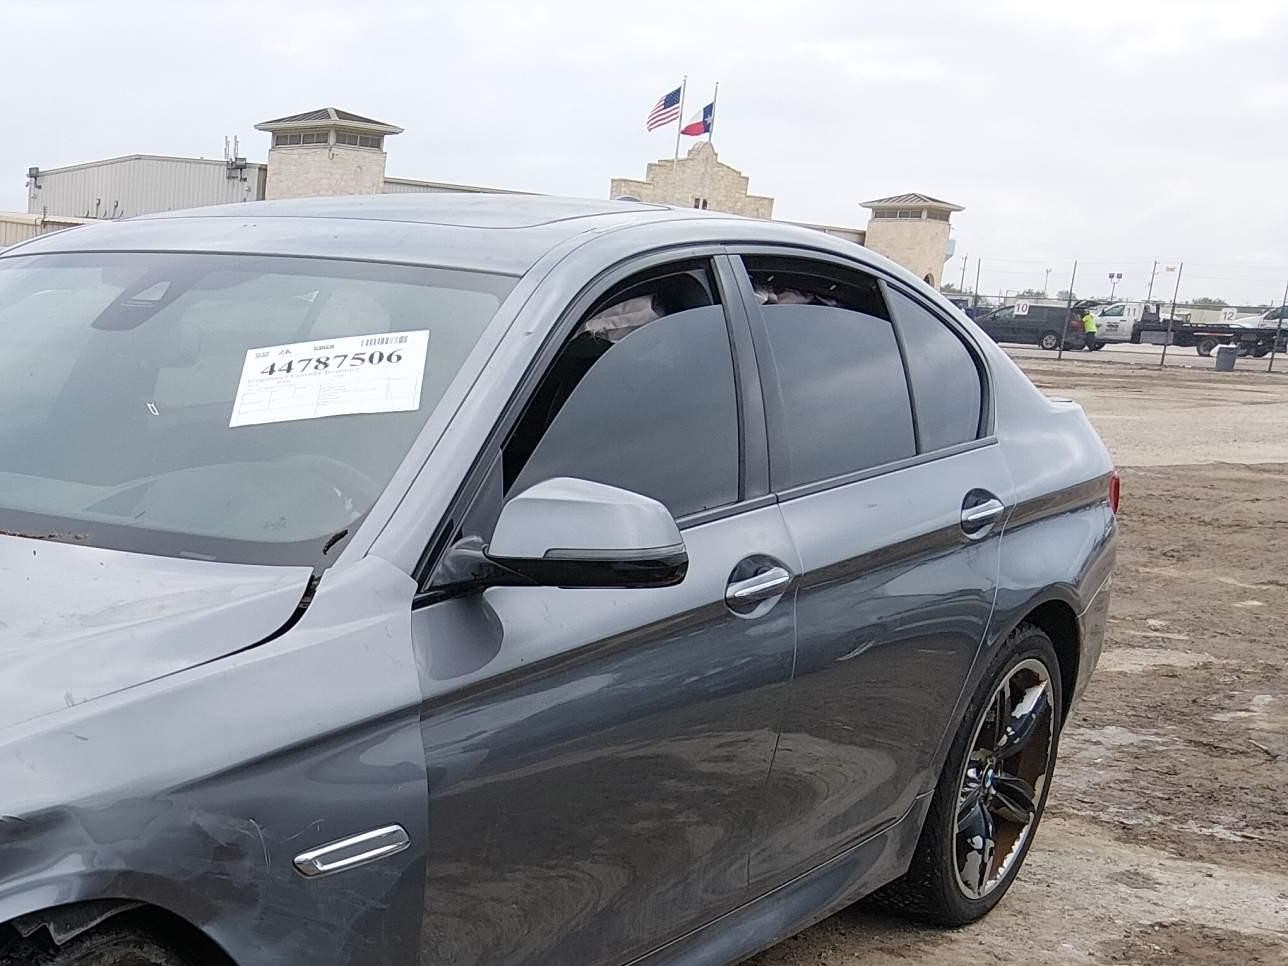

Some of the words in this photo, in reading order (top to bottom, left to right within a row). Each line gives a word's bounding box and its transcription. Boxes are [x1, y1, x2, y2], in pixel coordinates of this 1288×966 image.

[1016, 303, 1029, 313] 10
[1223, 311, 1235, 321] 12
[260, 350, 403, 376] 44787506
